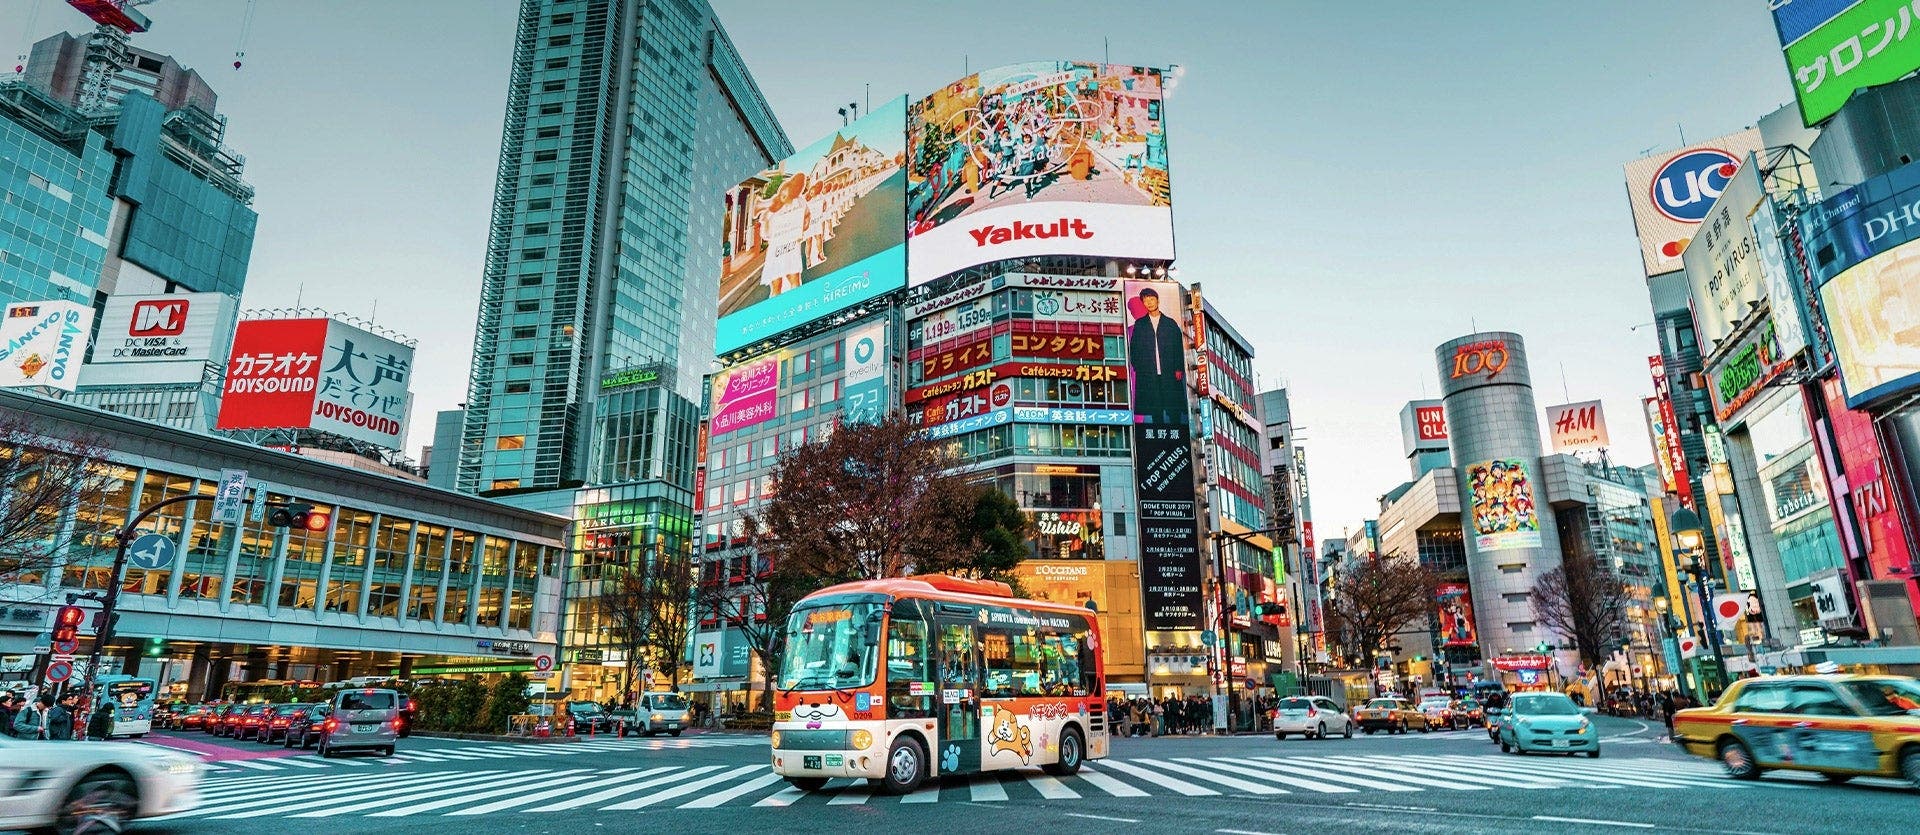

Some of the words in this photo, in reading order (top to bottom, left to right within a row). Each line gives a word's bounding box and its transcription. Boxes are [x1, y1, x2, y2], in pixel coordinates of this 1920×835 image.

[1660, 161, 1741, 208] UC
[1822, 194, 1860, 219] Channel
[969, 219, 1094, 247] Yakult
[1024, 275, 1117, 289] しゃぶしゃぶバイキング
[1064, 296, 1119, 314] しゃぶ葉
[135, 304, 180, 331] DC
[51, 309, 82, 380] SANKYO
[144, 337, 166, 346] VISA
[910, 328, 922, 341] 9F
[1013, 335, 1100, 354] コンタクト
[131, 346, 188, 357] MasterCard
[324, 338, 408, 387] 大声
[925, 342, 991, 375] プライス
[233, 351, 317, 376] カラオケ
[740, 363, 775, 383] 品川スキン
[1076, 366, 1117, 382] ガスト
[1450, 348, 1508, 381] 109
[228, 377, 315, 394] JOYSOUND
[741, 376, 771, 393] クリニック
[963, 369, 997, 391] ガスト
[315, 400, 400, 436] JOYSOUND
[720, 401, 773, 428] 品川美容外科
[909, 410, 923, 426] 7F
[946, 394, 986, 422] ガスト
[1555, 405, 1596, 434] H&M
[1563, 436, 1590, 446] 150m
[223, 473, 242, 518] 渋谷駅前
[581, 516, 617, 529] MARK
